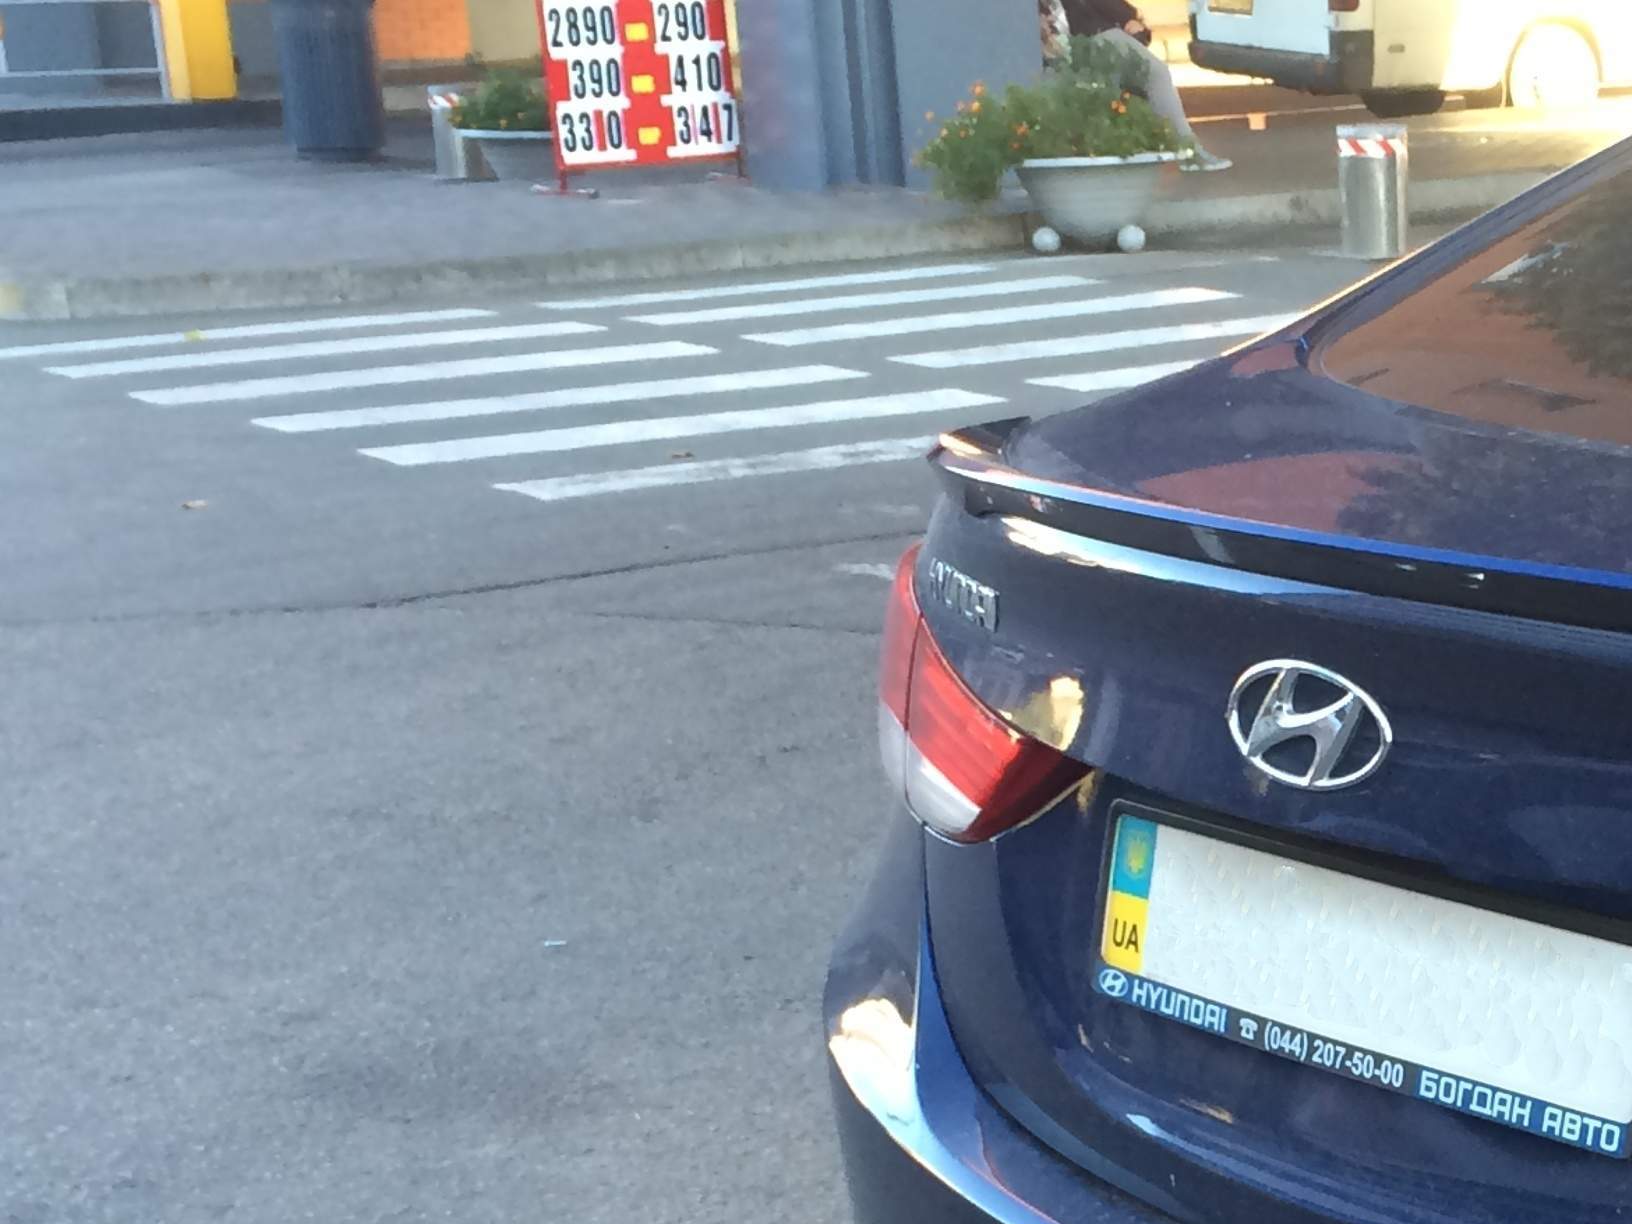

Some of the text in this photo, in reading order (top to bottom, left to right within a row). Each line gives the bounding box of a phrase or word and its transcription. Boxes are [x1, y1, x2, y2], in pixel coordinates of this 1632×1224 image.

[547, 1, 706, 47] 2890 290
[571, 51, 722, 99] 390 410
[1112, 917, 1140, 954] UA
[1132, 979, 1228, 1033] HYUNDAI
[1264, 1020, 1405, 1088] (044) 207-50-00
[1418, 1069, 1621, 1153] БОГДАН АВТО
